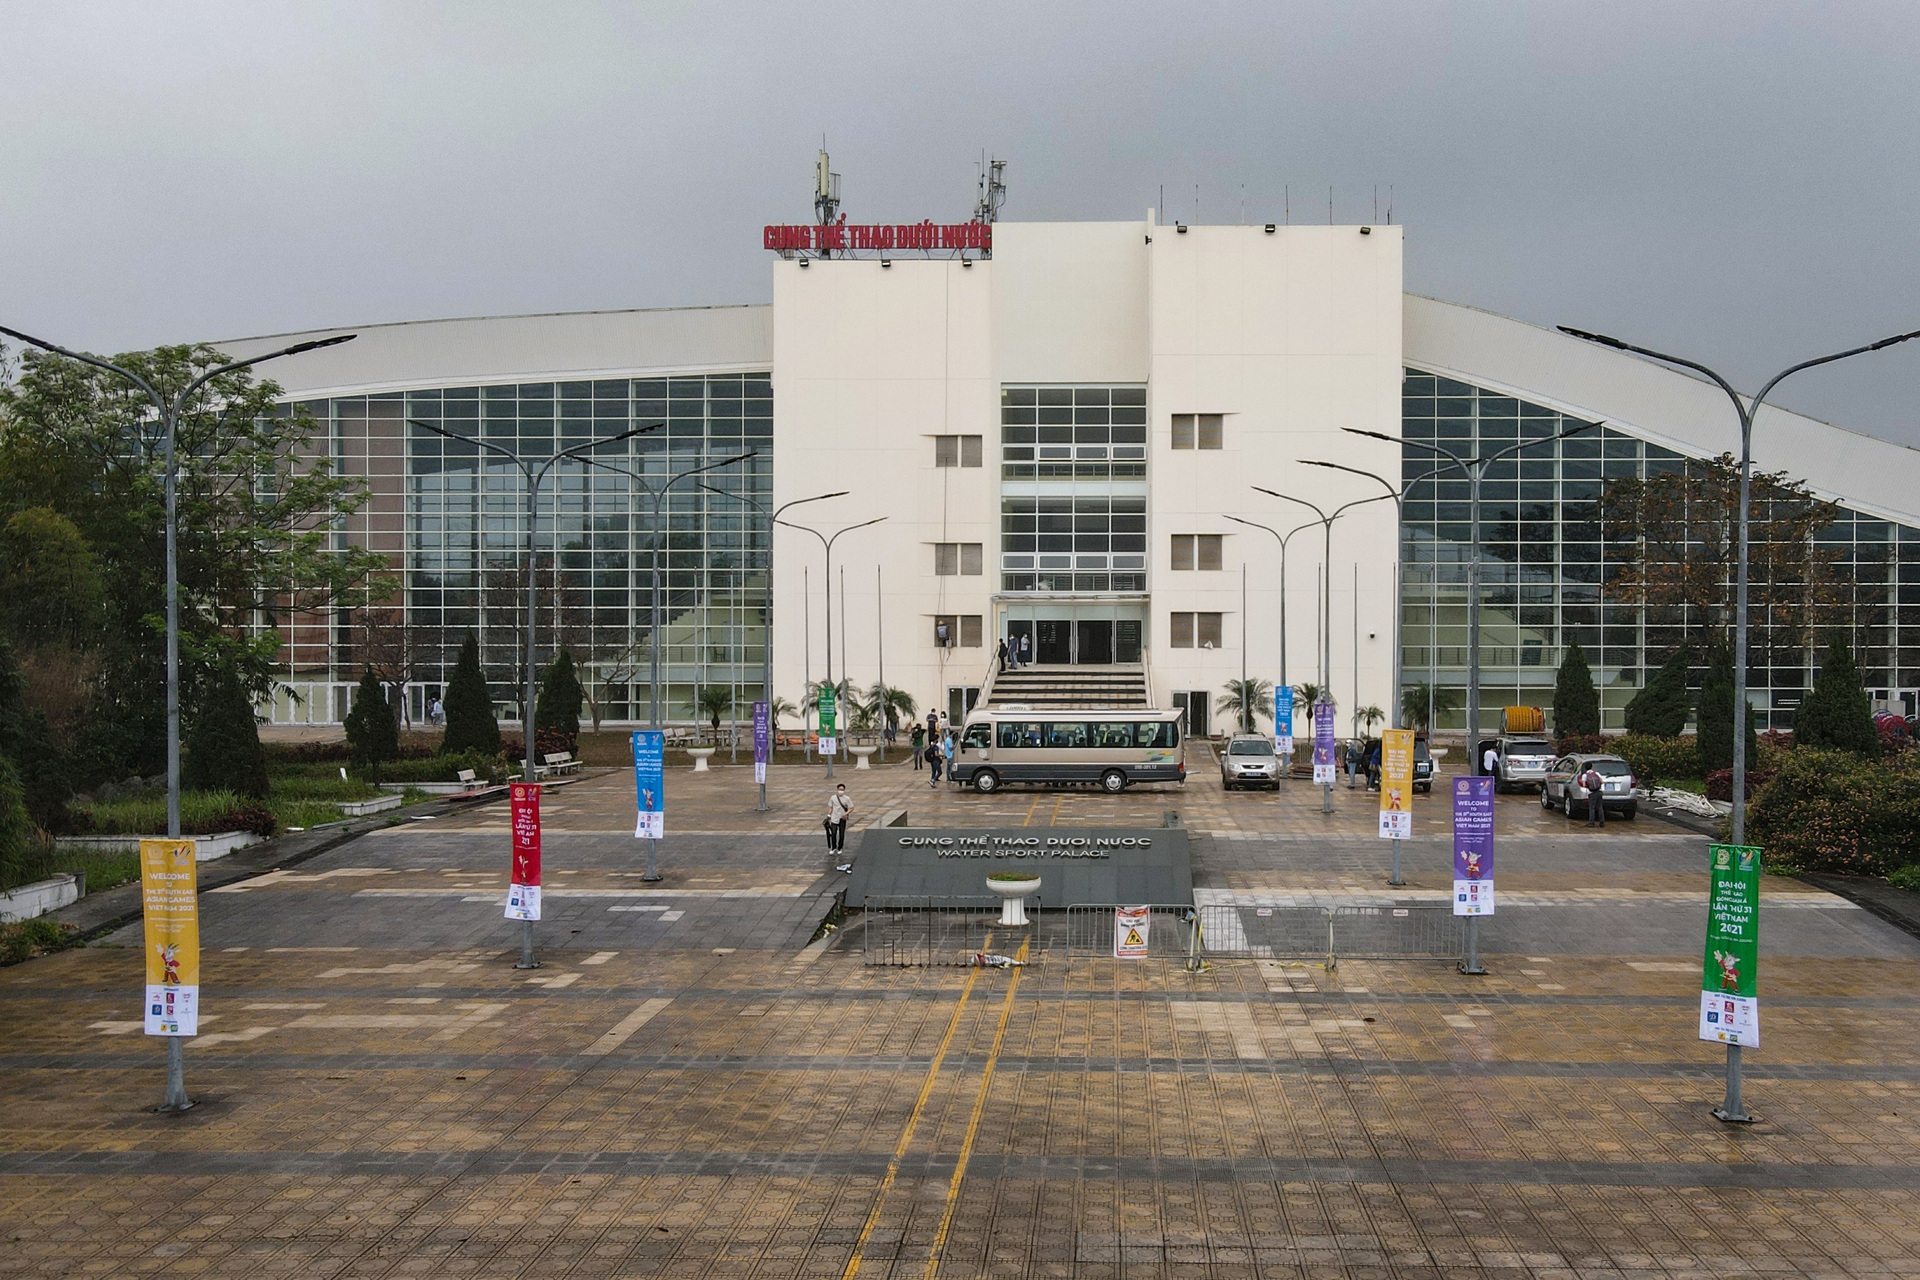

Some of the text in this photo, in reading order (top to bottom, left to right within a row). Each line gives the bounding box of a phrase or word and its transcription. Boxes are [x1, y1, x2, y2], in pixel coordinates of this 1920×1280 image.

[764, 224, 811, 249] CUNG
[848, 224, 894, 249] THAO
[896, 218, 939, 249] DƯỚI
[942, 218, 992, 249] NƯỚC
[899, 837, 954, 845] CUNG
[992, 837, 1040, 845] THAO
[937, 849, 1110, 857] WATER SPORT PALACE
